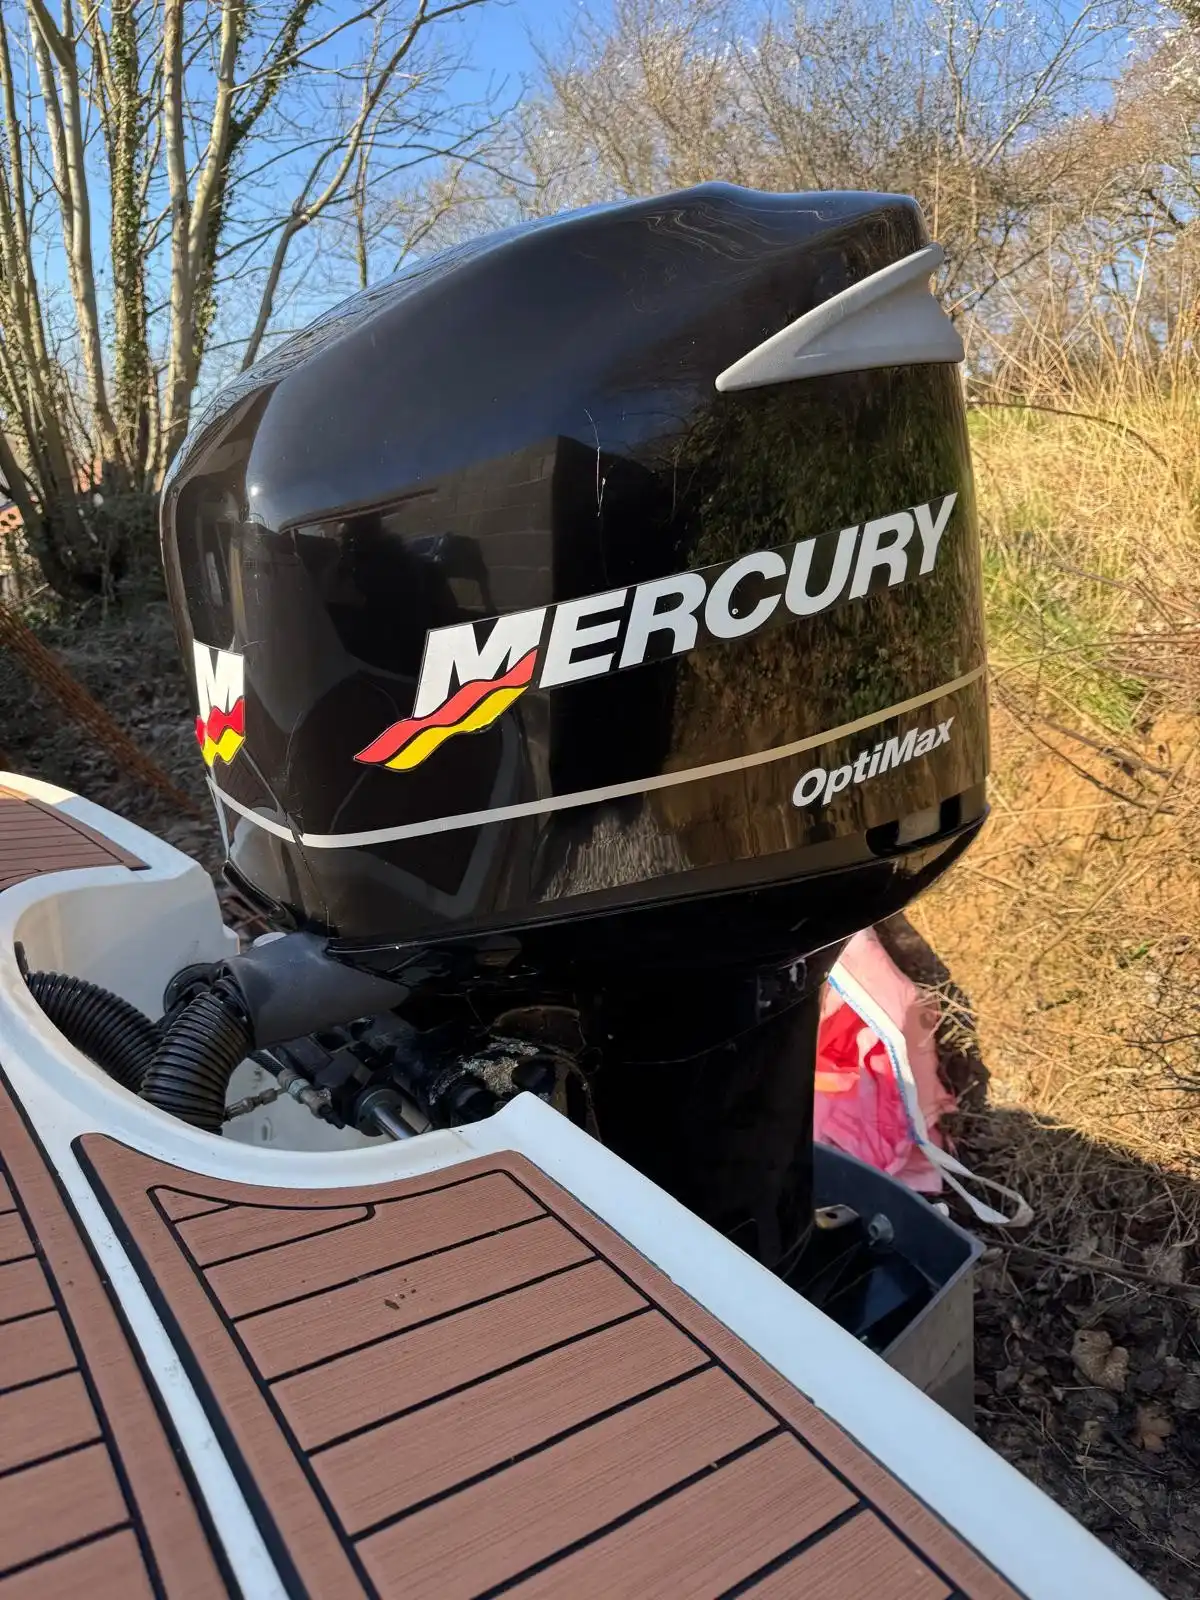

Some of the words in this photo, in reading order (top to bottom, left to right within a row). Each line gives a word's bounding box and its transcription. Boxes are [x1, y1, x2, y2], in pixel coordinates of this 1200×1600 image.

[413, 492, 958, 719] MERCURY
[193, 640, 245, 725] M
[793, 716, 956, 808] OptiMax
